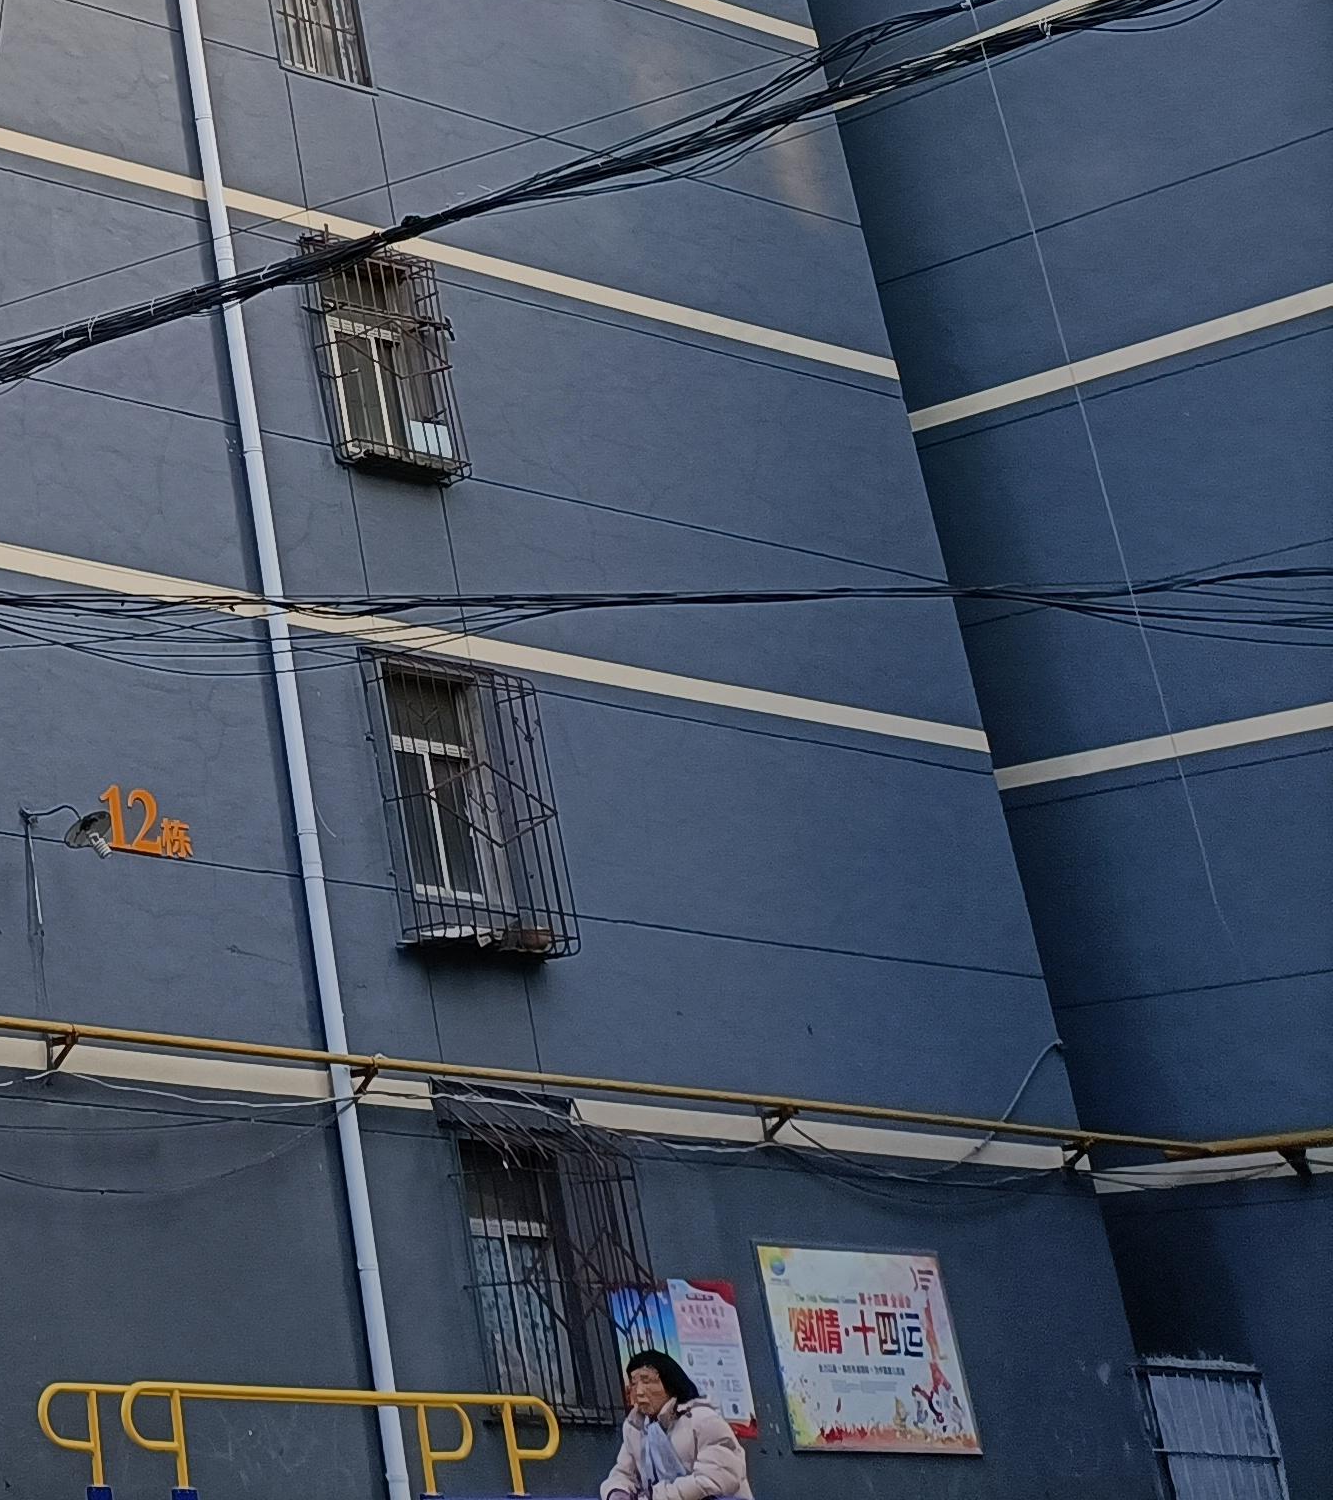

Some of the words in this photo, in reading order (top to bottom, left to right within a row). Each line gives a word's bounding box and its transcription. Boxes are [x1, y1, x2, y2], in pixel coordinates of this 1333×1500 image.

[99, 784, 193, 857] 12栋
[788, 1307, 923, 1357] 燃情·十四运
